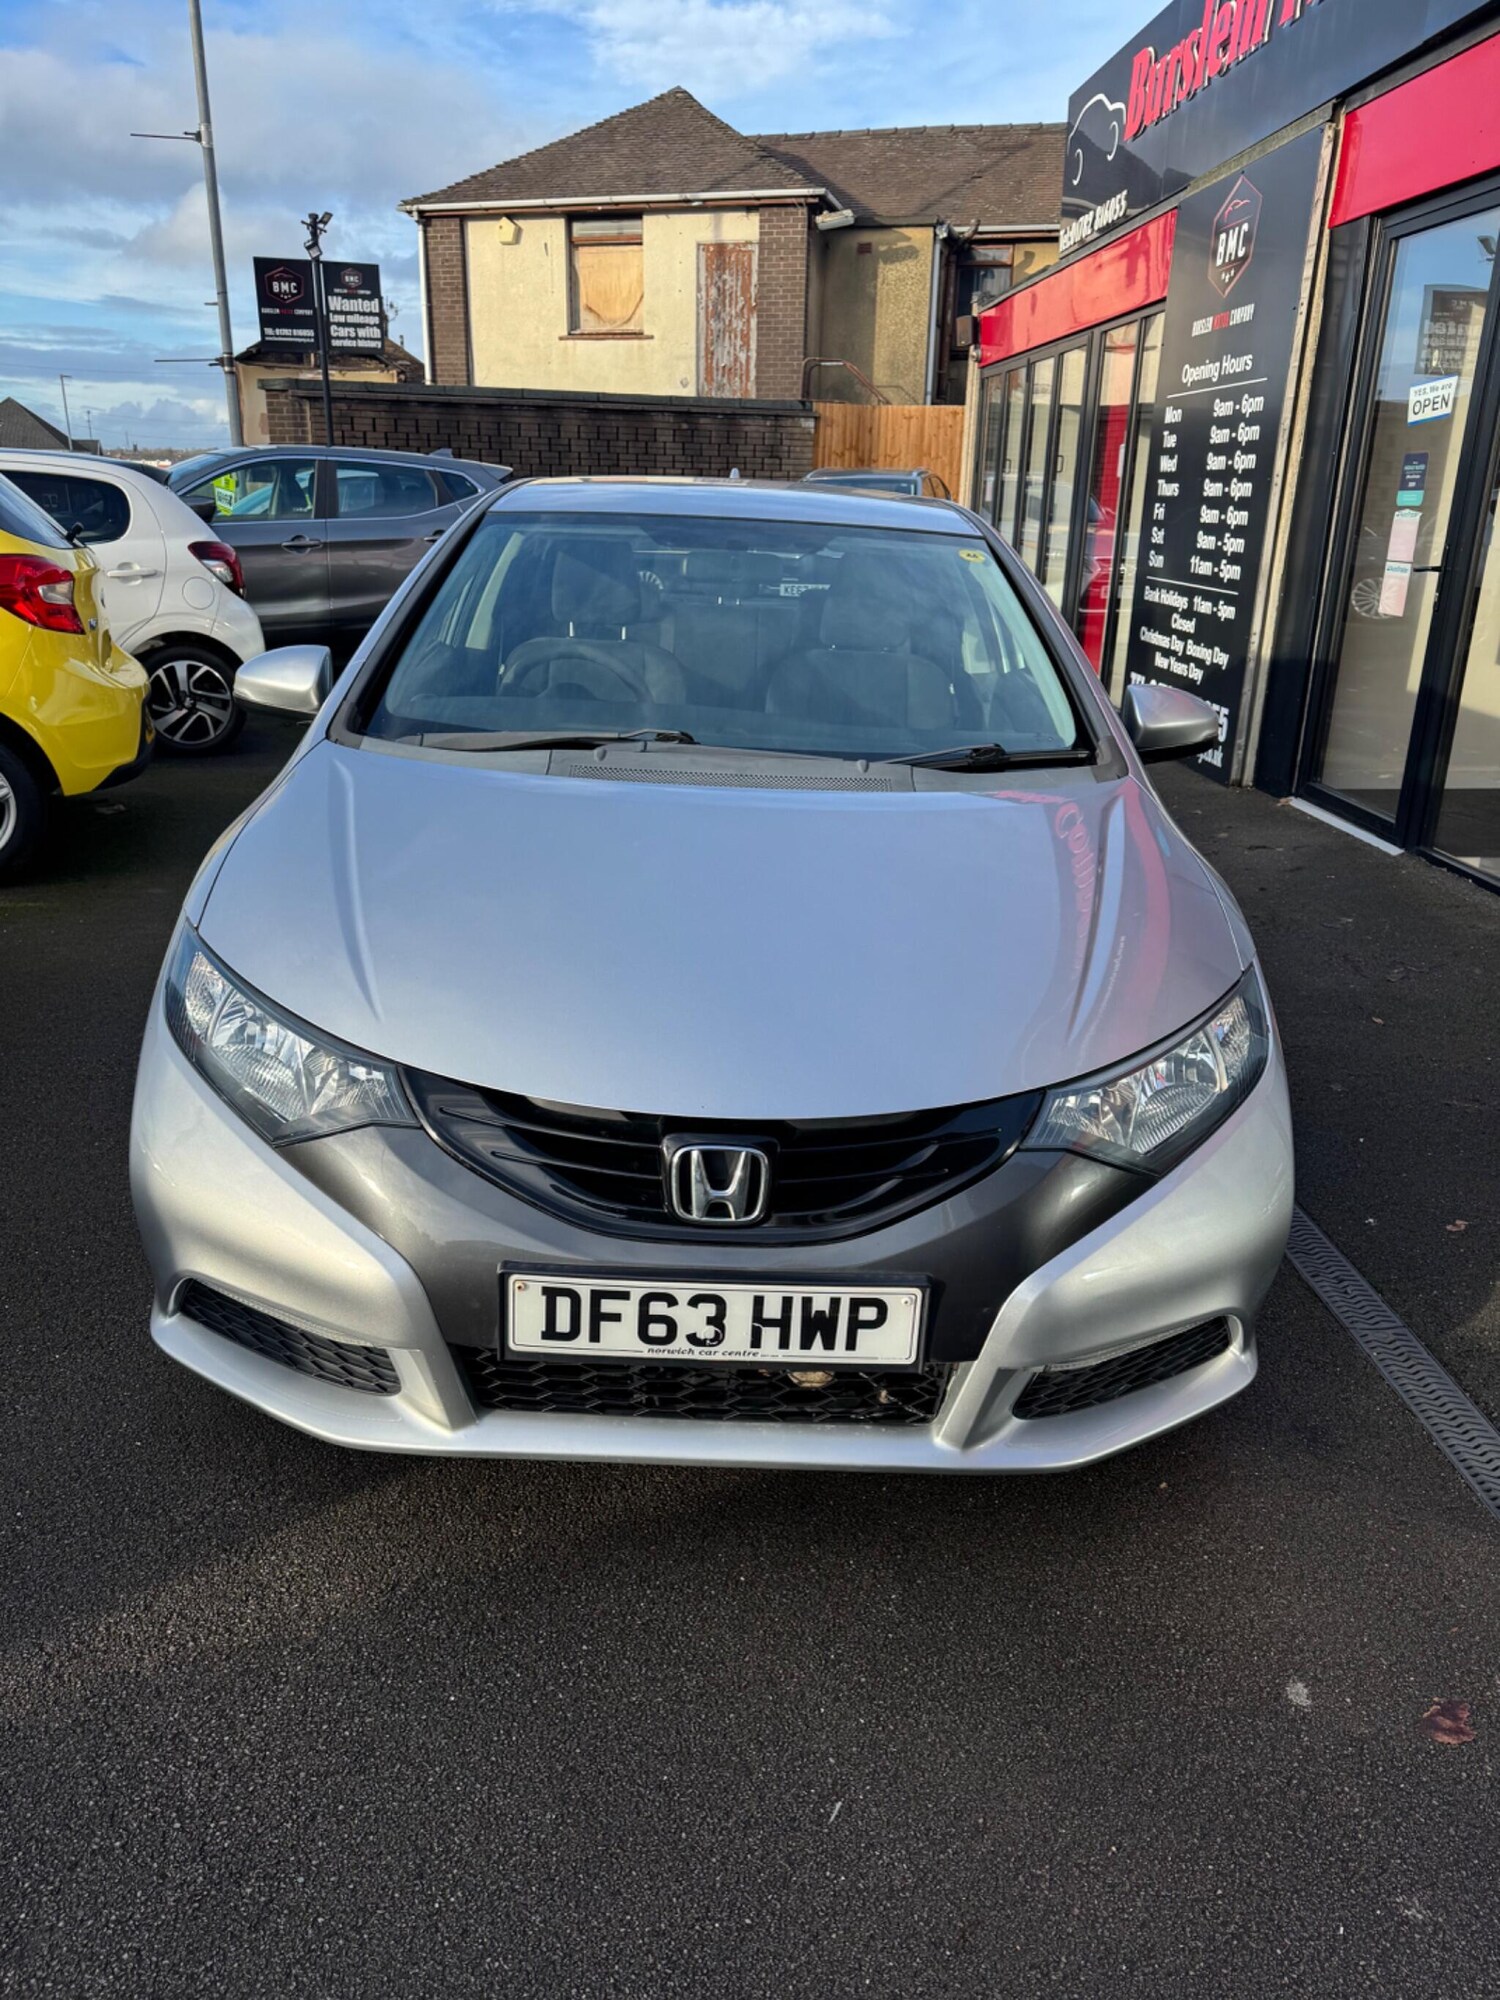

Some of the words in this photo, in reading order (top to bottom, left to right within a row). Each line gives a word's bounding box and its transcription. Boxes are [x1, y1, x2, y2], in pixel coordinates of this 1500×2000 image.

[1216, 222, 1249, 267] BMC
[272, 281, 298, 293] BMC
[327, 295, 380, 313] Wanted
[329, 312, 345, 323] Low
[346, 314, 379, 325] mileage
[330, 324, 356, 338] Cars
[356, 326, 381, 339] with
[331, 338, 357, 347] service
[357, 339, 382, 349] history
[1181, 359, 1220, 387] Opening
[1221, 354, 1253, 375] Hours
[1164, 406, 1182, 424] Mon
[1213, 398, 1234, 417] 9am
[1241, 393, 1264, 418] 6pm
[1412, 392, 1451, 416] OPEN
[1162, 430, 1177, 448] Tue
[1209, 425, 1230, 444] 9am
[1237, 422, 1260, 446] 6pm
[1160, 454, 1178, 472] Wed
[1206, 452, 1226, 471] 9am
[1233, 450, 1256, 474] 6pm
[1157, 479, 1180, 497] Thurs
[1202, 477, 1223, 497] 9am
[1230, 477, 1253, 502] 6pm
[1153, 503, 1166, 520] Fri
[1199, 504, 1220, 524] 9am
[1226, 505, 1249, 530] 6pm
[1151, 526, 1165, 544] Sat
[1196, 530, 1216, 550] 9am
[1222, 532, 1245, 557] 5pm
[1148, 550, 1164, 568] Sun
[1190, 555, 1213, 576] 11am
[1219, 558, 1241, 583] 5pm
[1144, 585, 1160, 602] Bank
[1160, 588, 1189, 612] Holidays
[1193, 595, 1213, 615] 11am
[1217, 600, 1236, 622] 5pm
[1171, 612, 1196, 634] Closed
[1139, 626, 1171, 649] Christmas
[1170, 634, 1185, 656] Day
[1186, 639, 1213, 666] Boxing
[1212, 646, 1230, 670] Day
[1154, 651, 1170, 670] New
[1169, 655, 1188, 677] Years
[1188, 662, 1204, 685] Day
[540, 1285, 728, 1348] DF63
[749, 1294, 889, 1352] HWP
[647, 1345, 696, 1356] norwich
[699, 1349, 720, 1357] car
[721, 1348, 760, 1359] centre
